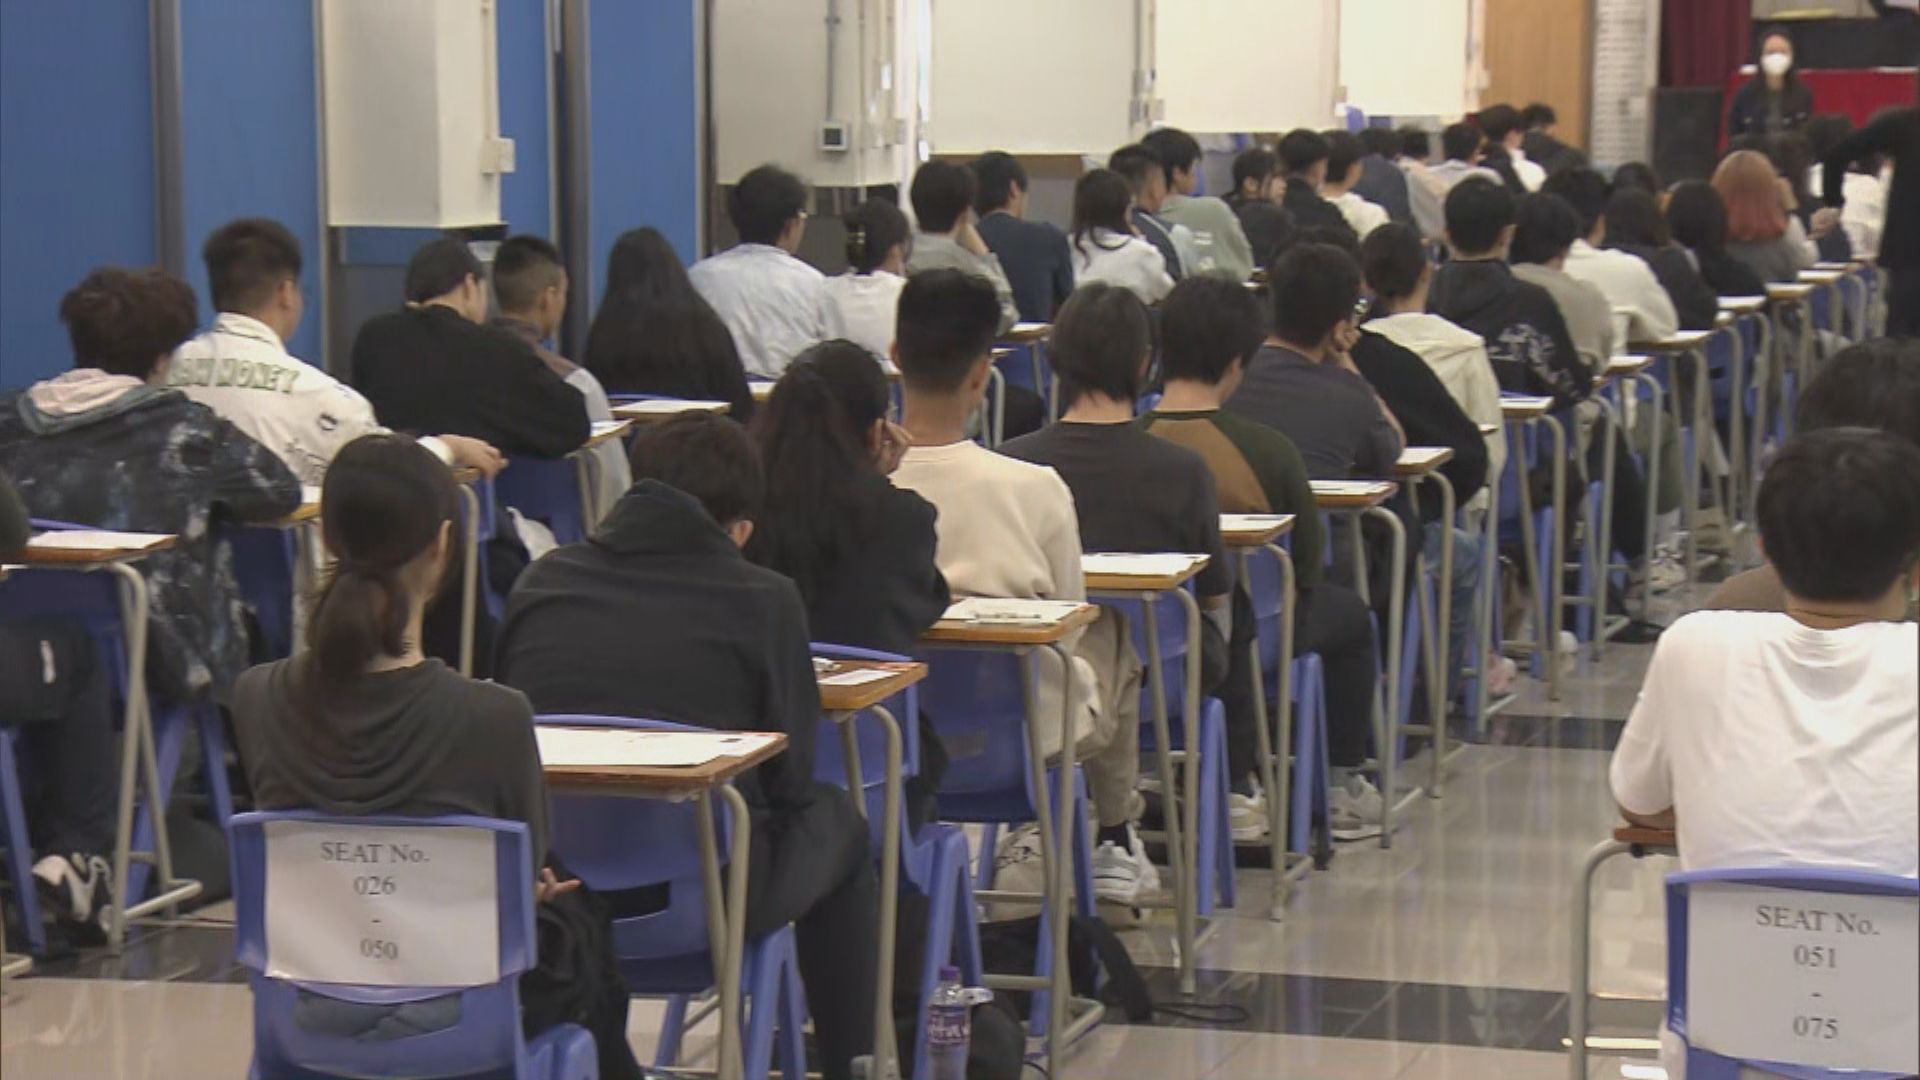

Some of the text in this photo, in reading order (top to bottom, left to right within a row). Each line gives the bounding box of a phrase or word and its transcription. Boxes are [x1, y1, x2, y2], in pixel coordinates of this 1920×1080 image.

[216, 358, 300, 394] MONEY
[321, 842, 430, 863] SEAT No.
[353, 876, 396, 895] 026
[1756, 904, 1880, 936] SEAT No.
[360, 939, 398, 960] 050
[1793, 944, 1836, 968] 051
[1793, 1016, 1838, 1039] 075
